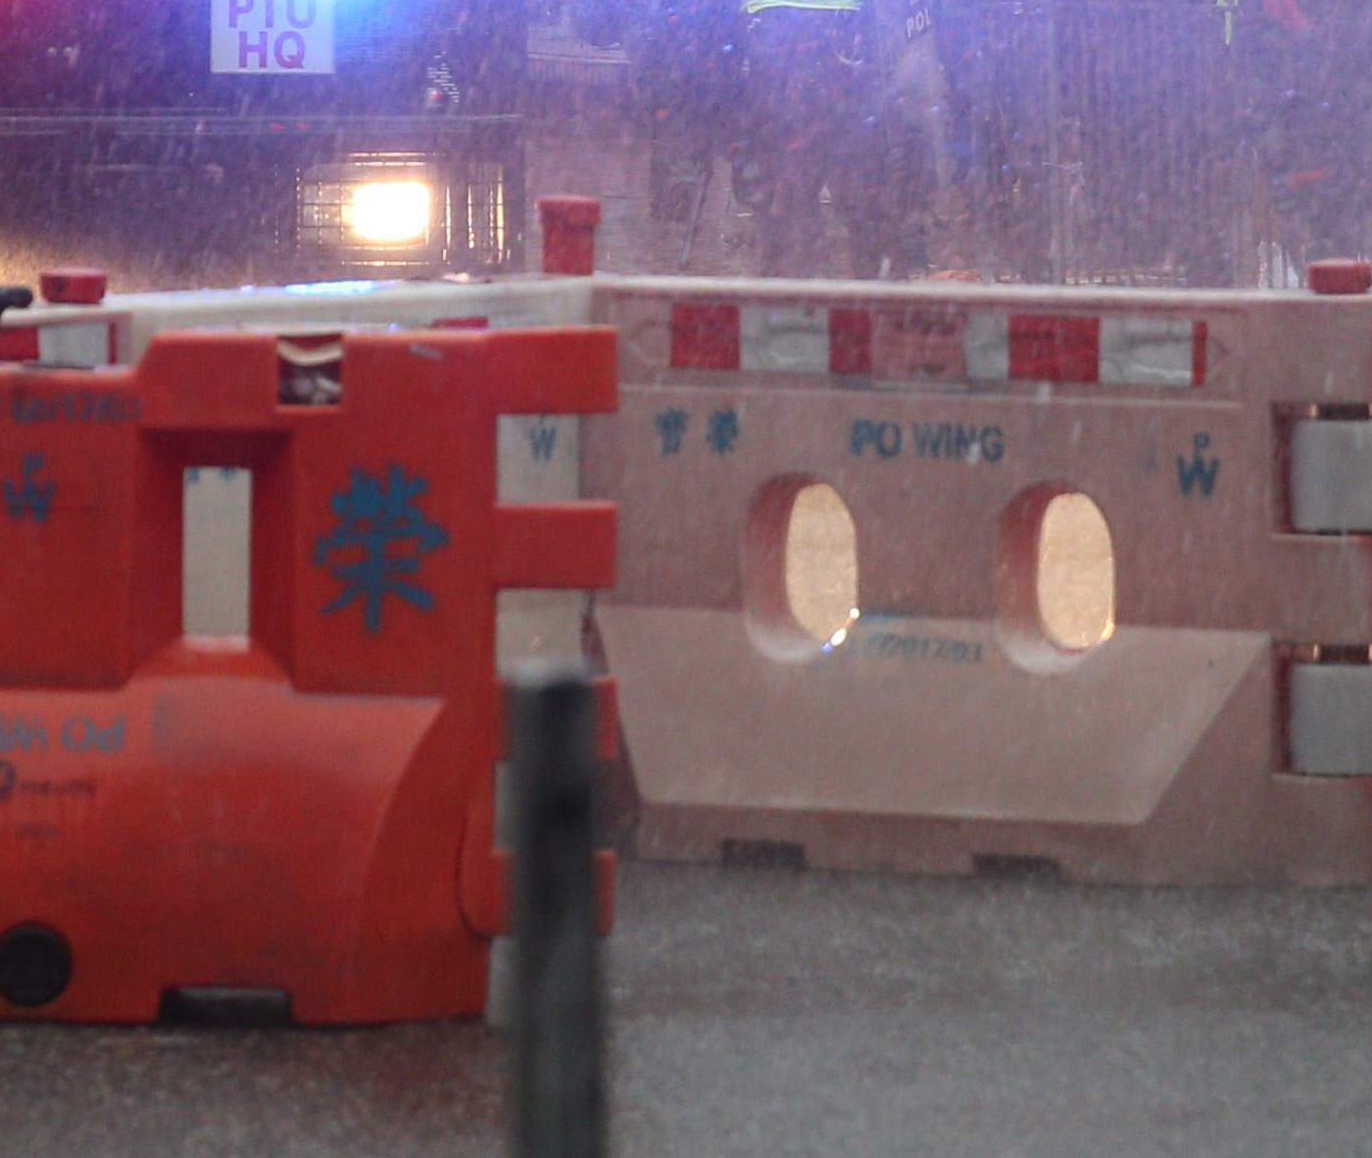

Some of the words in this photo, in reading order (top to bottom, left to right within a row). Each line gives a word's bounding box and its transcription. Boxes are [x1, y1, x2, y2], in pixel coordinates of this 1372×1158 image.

[238, 30, 307, 69] HQ
[848, 417, 904, 458] PO
[911, 421, 1006, 463] WING
[311, 460, 449, 634] 榮
